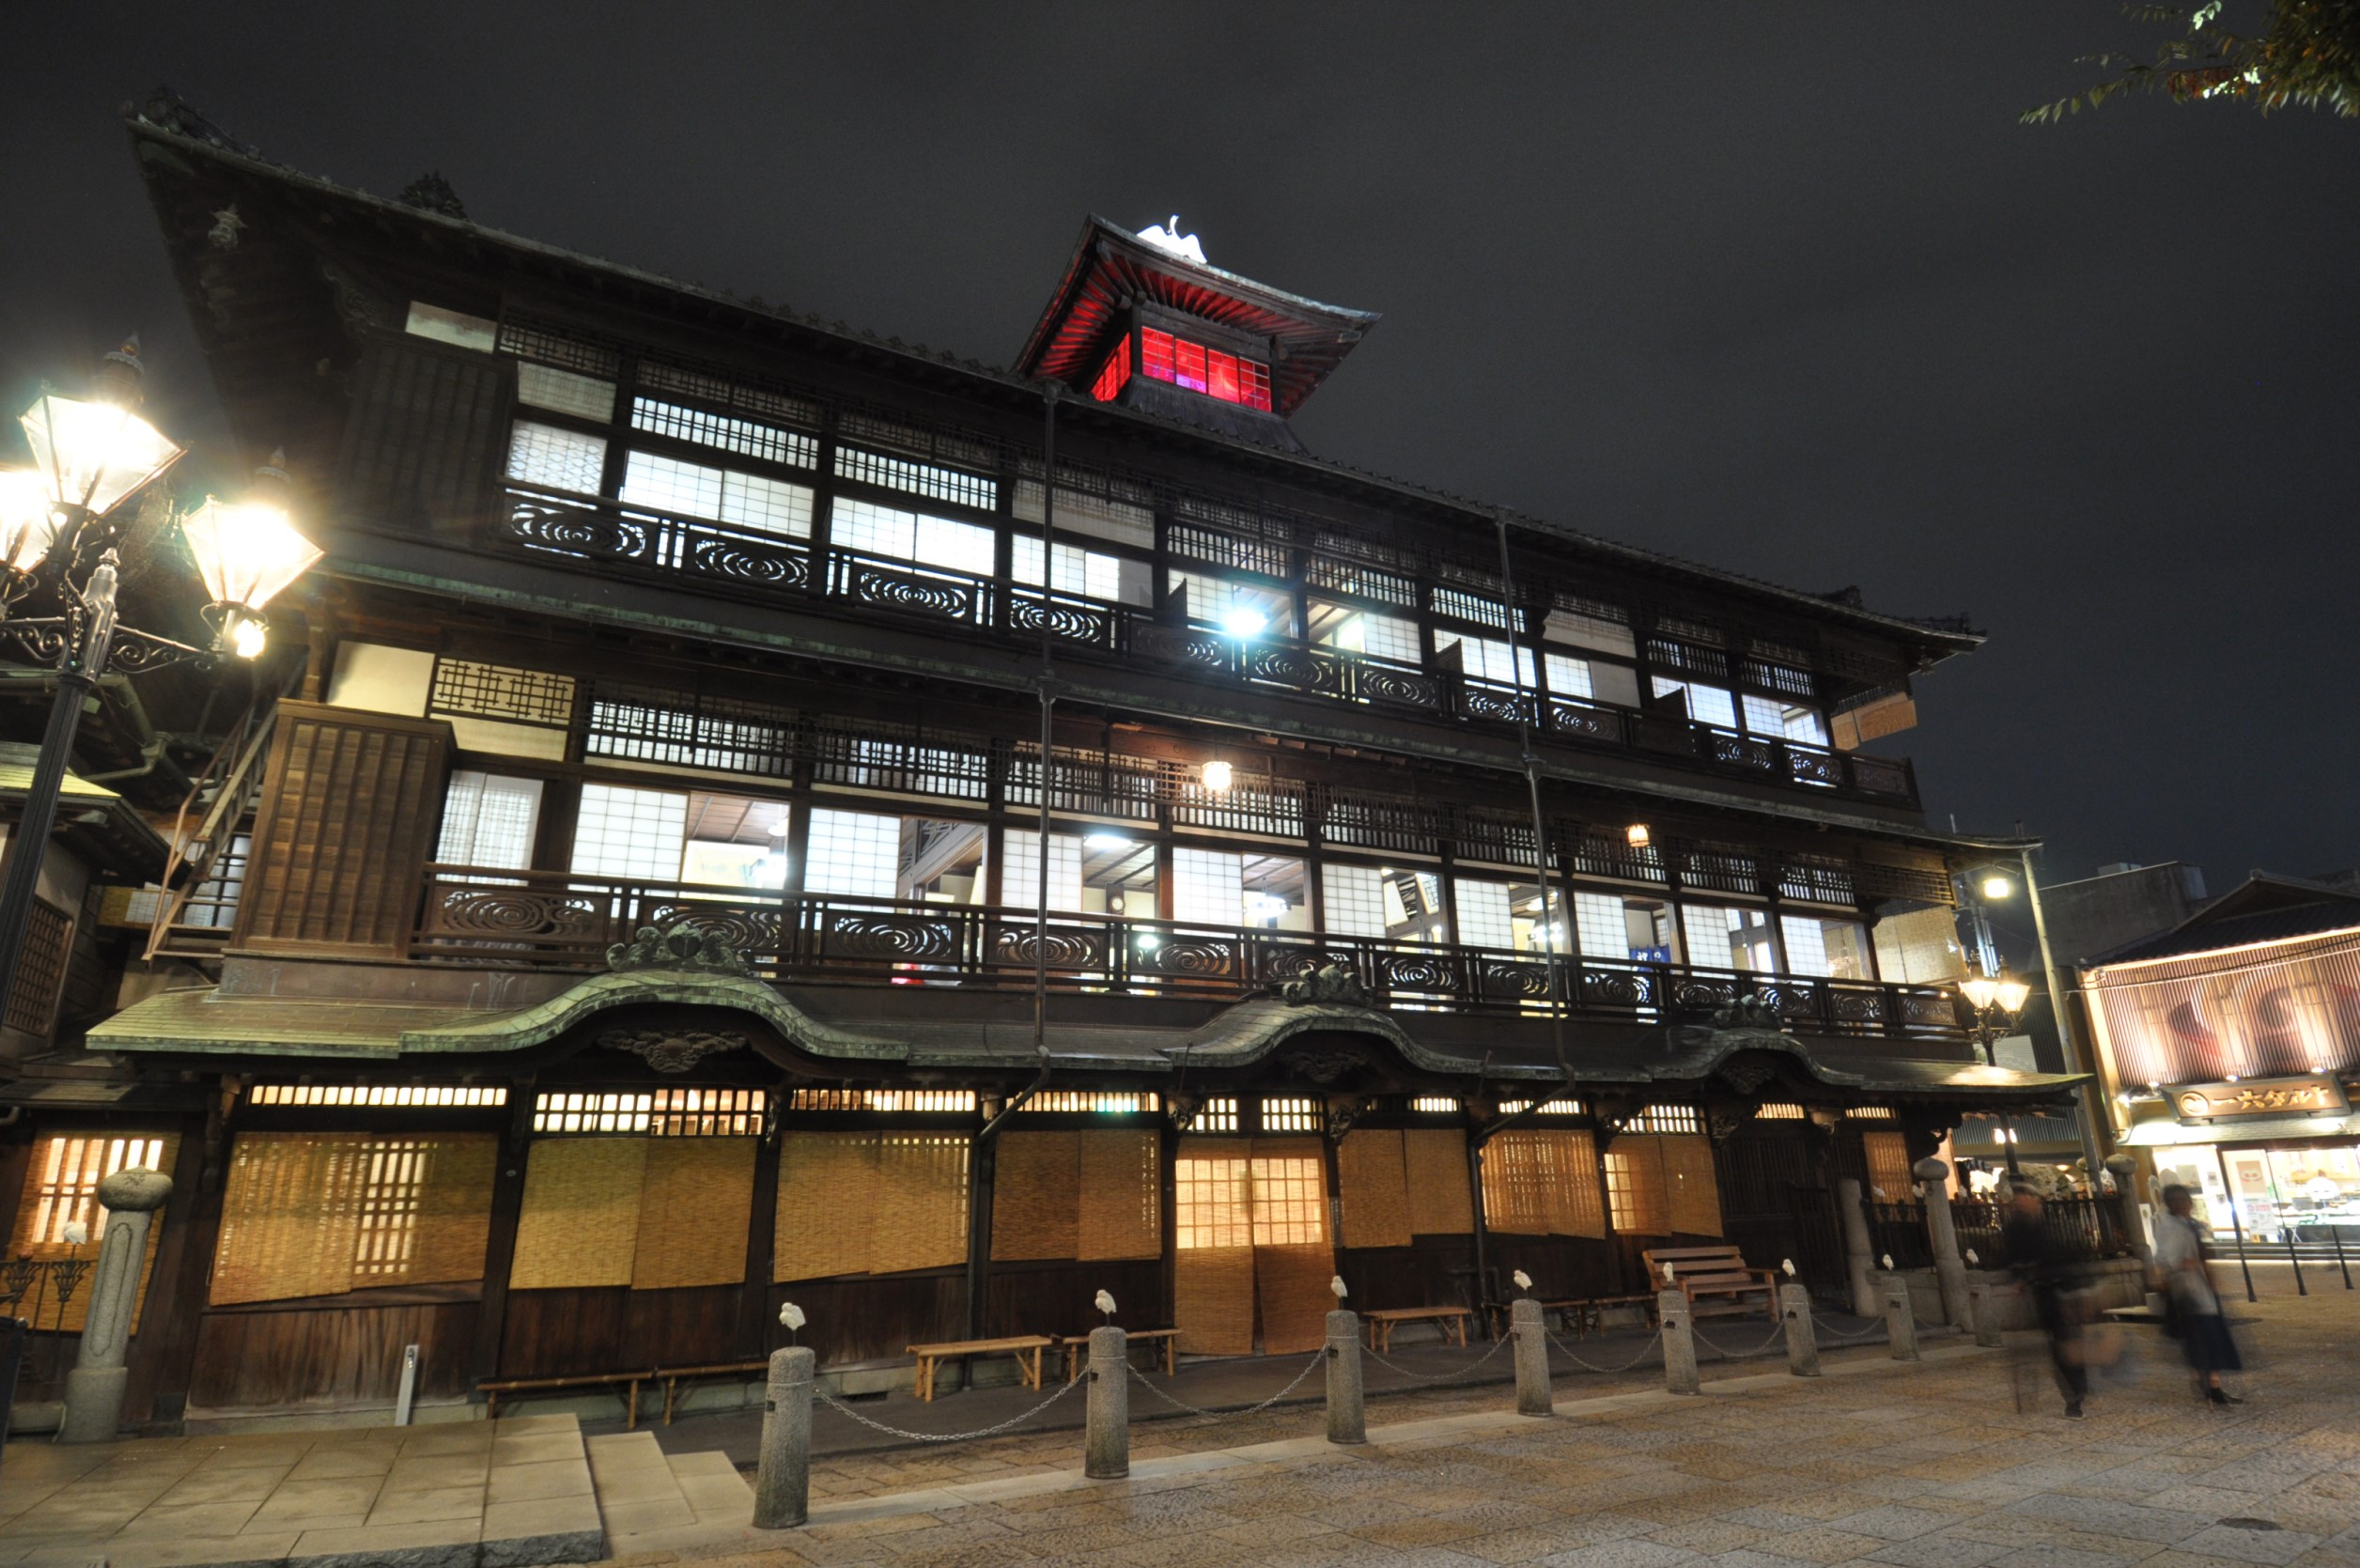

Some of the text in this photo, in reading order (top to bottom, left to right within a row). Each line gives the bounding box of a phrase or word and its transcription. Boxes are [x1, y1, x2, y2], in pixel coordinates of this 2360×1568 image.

[2211, 1084, 2329, 1110] 一六タルト
